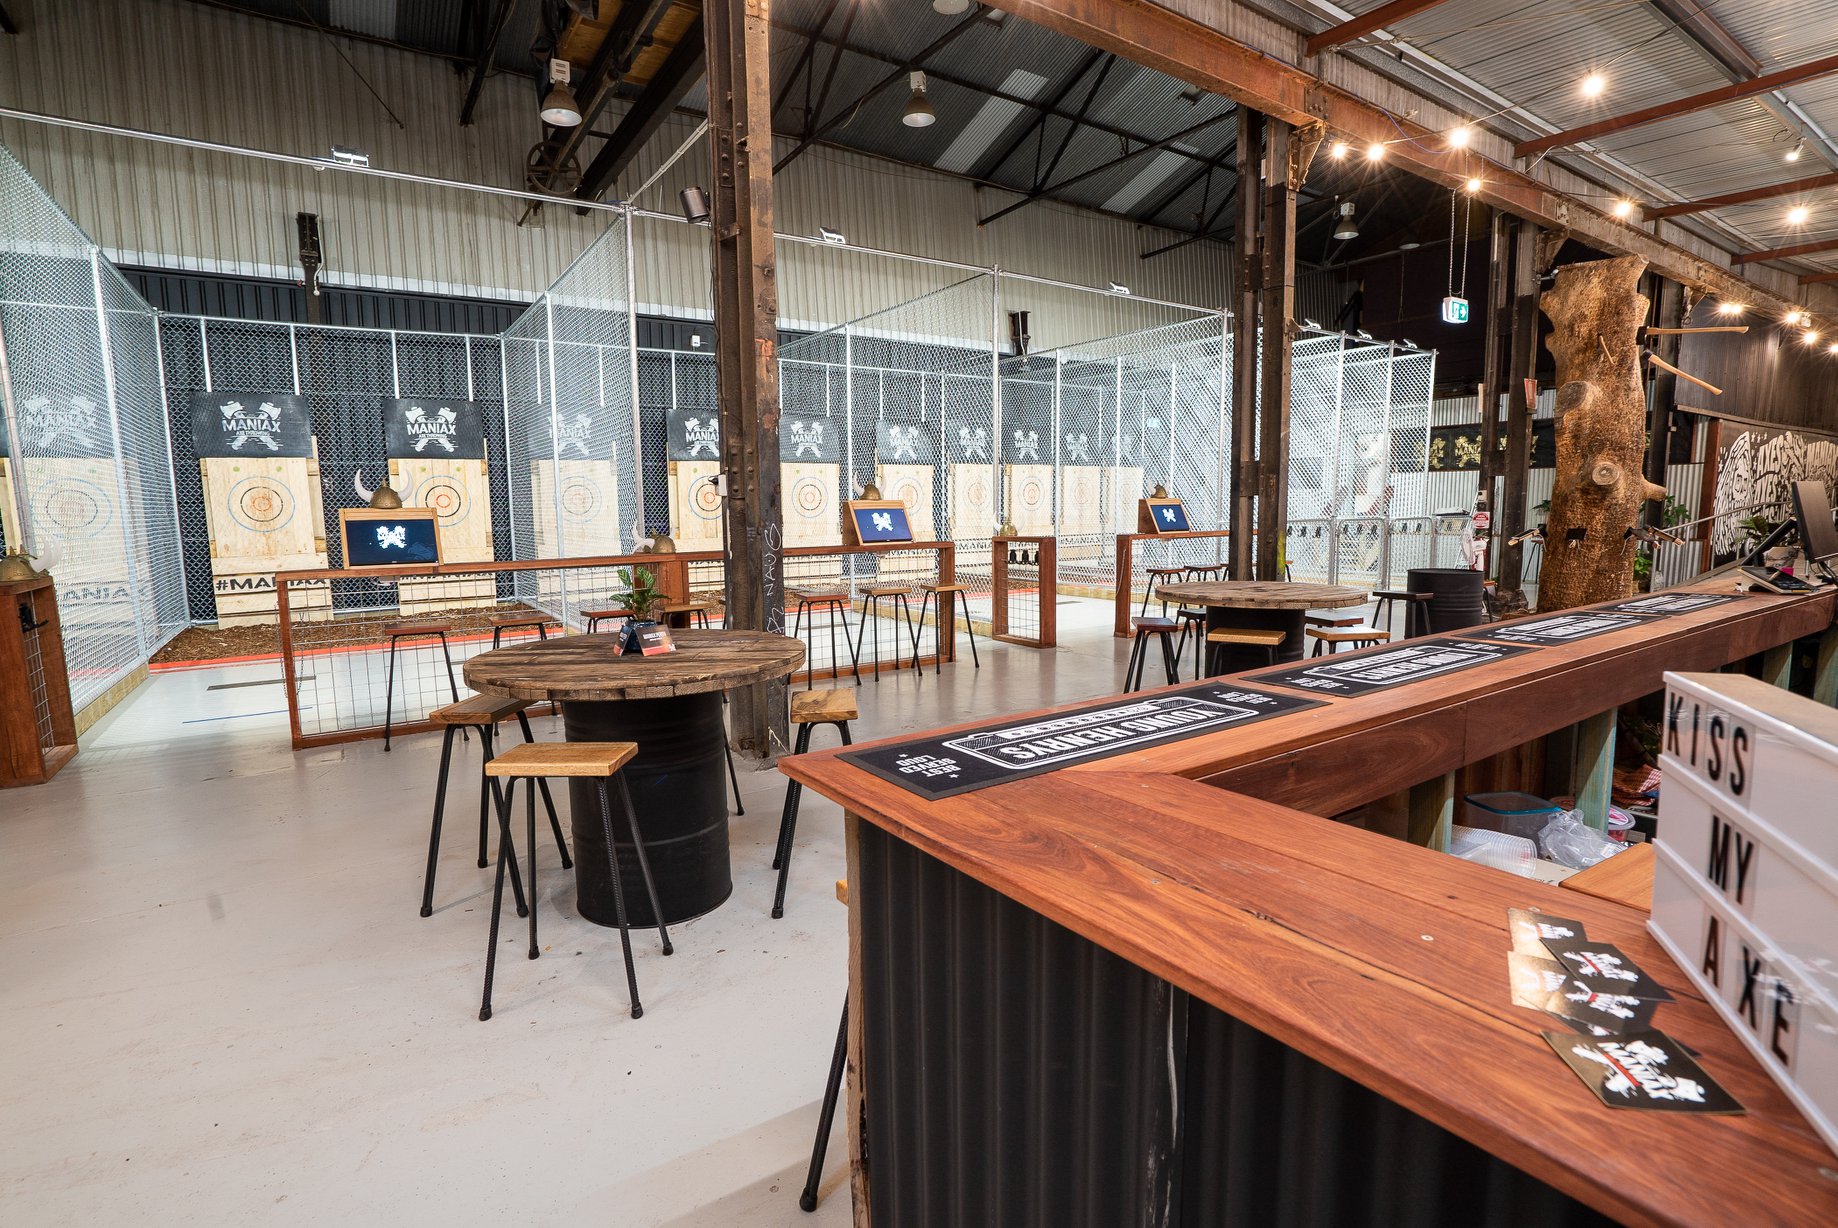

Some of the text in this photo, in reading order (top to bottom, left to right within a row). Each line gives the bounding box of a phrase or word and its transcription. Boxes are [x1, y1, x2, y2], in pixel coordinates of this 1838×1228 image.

[222, 418, 281, 432] MANIAX
[407, 422, 456, 435] MANIAX
[215, 576, 327, 591] #MAIAX
[1000, 707, 1226, 760] YOUNG HENRYS
[1666, 691, 1749, 797] KISS
[895, 754, 937, 766] LOUD
[899, 757, 957, 774] SERVED
[921, 764, 962, 777] BEST
[1708, 814, 1755, 906] MY
[1702, 914, 1795, 1067] AXE
